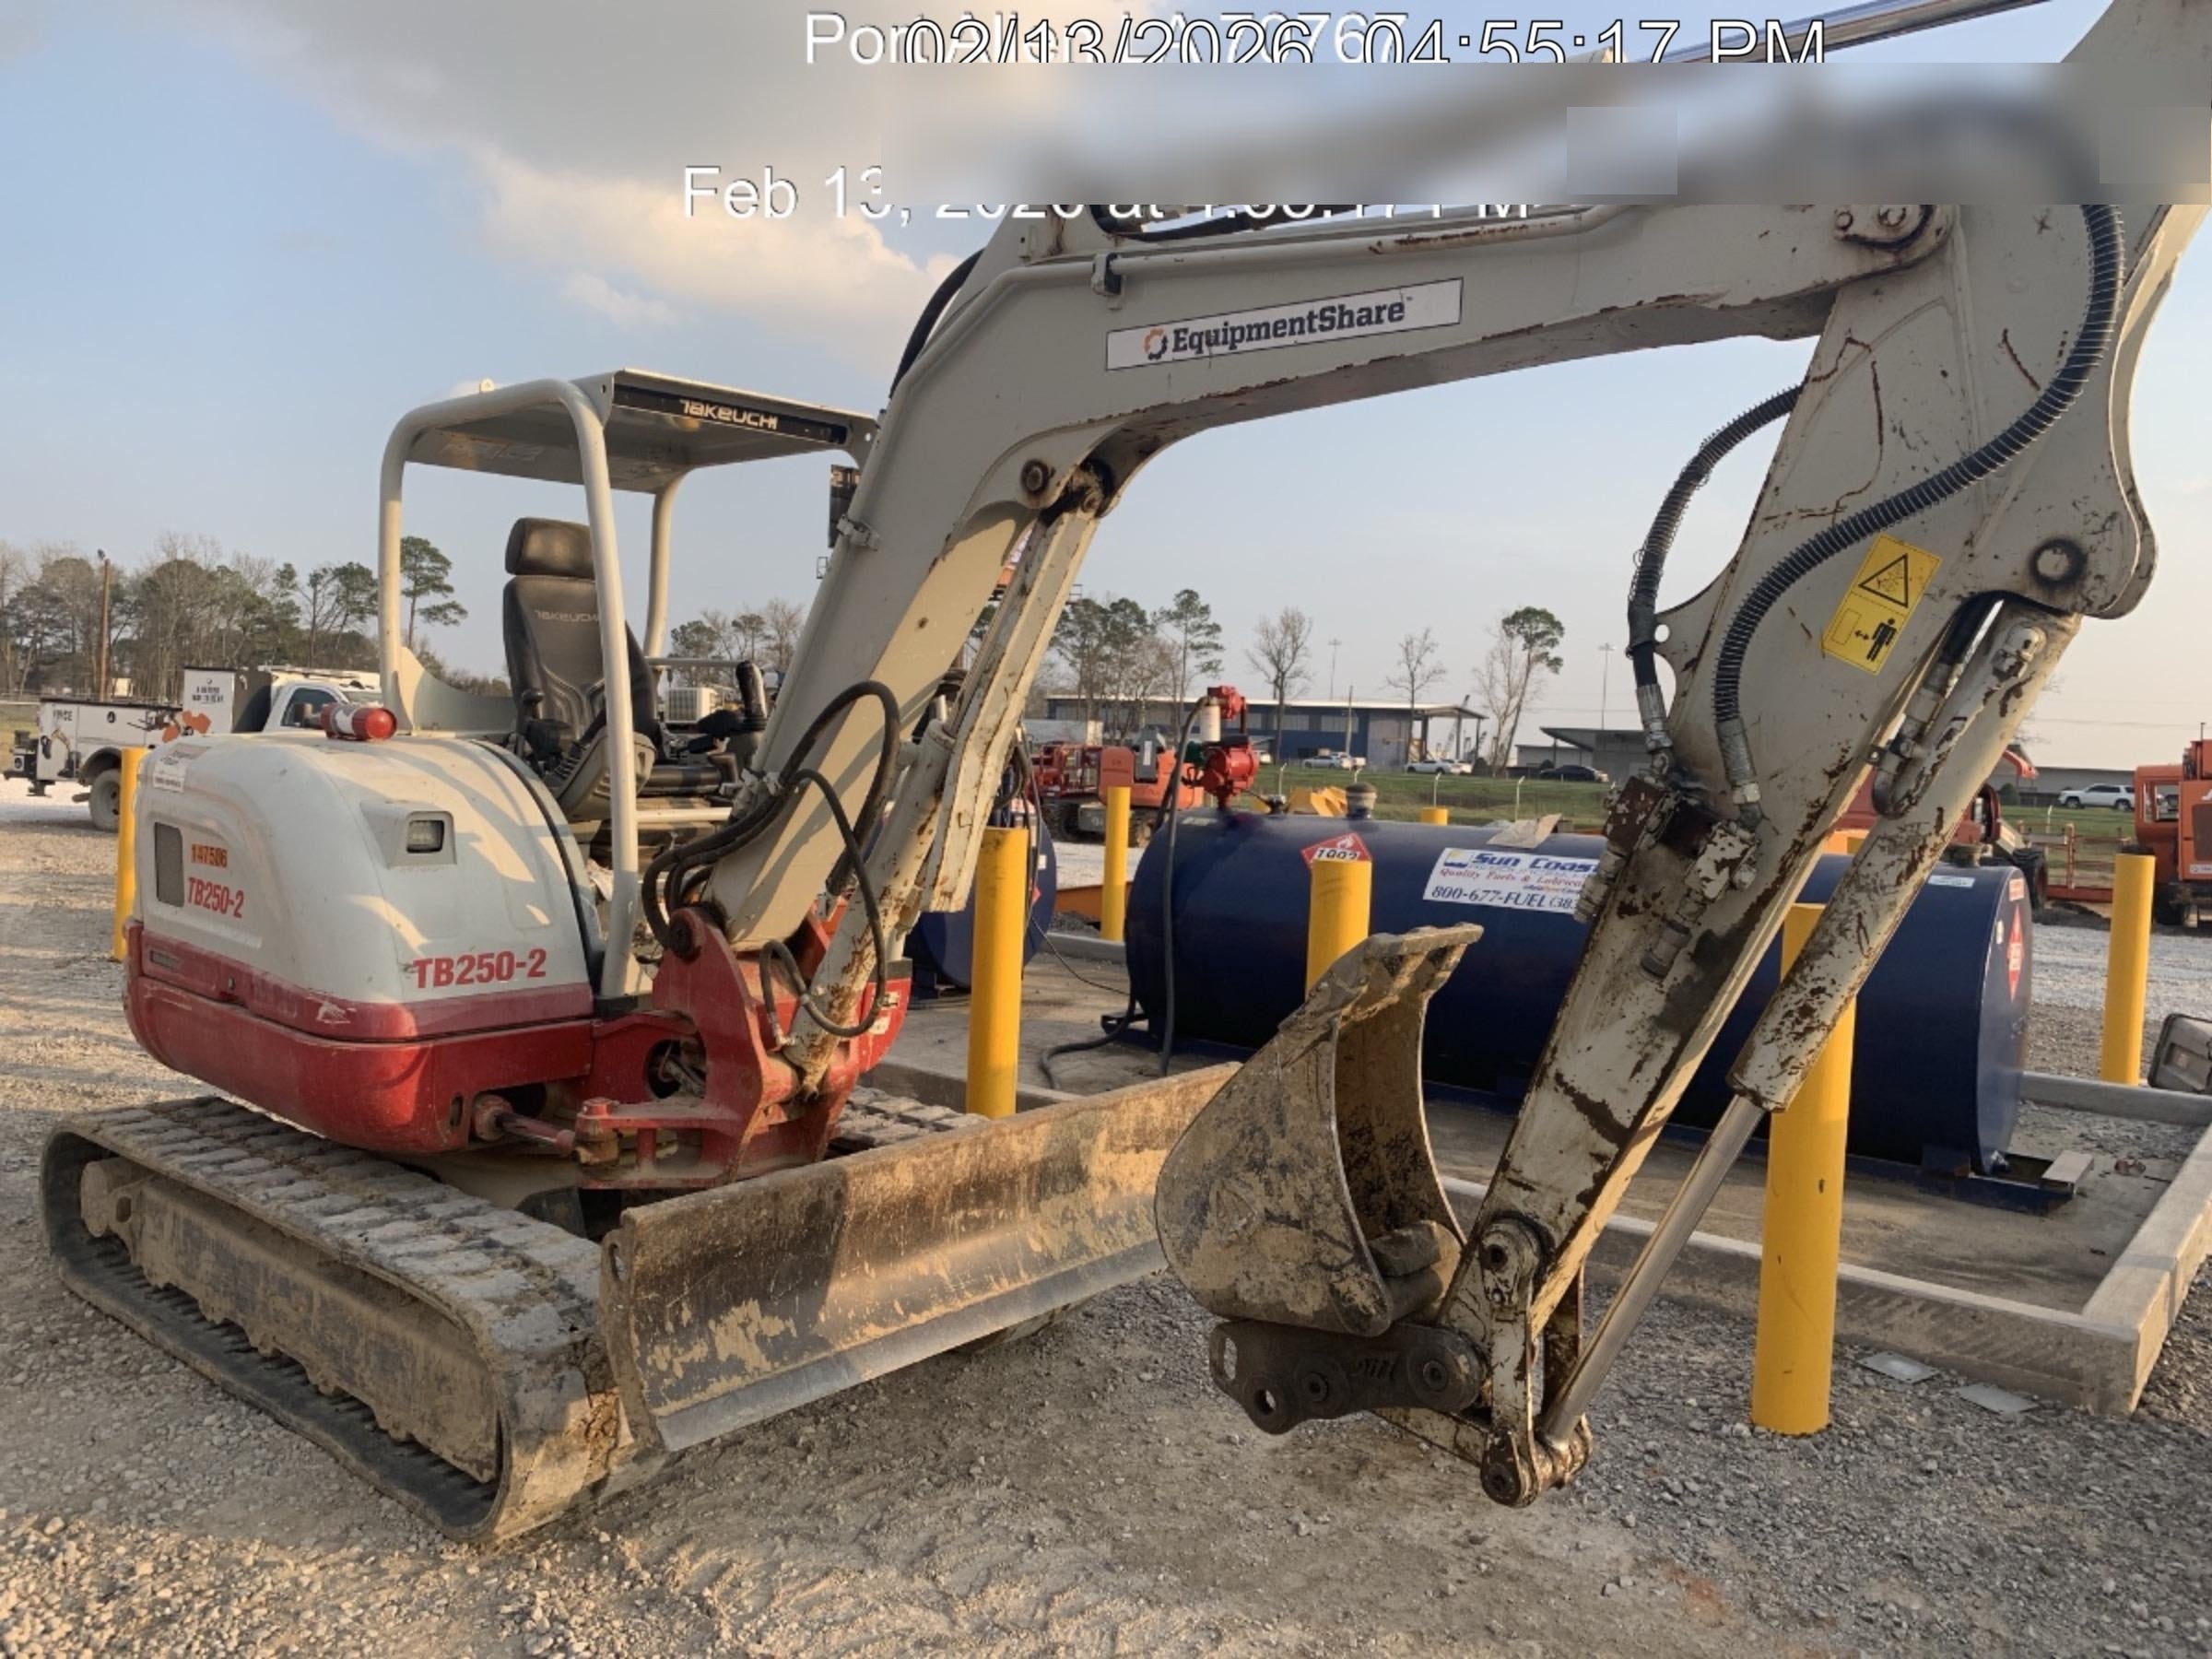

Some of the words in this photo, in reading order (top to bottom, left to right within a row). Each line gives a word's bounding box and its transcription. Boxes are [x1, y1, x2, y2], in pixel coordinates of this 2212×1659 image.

[1171, 300, 1406, 355] EquipmentShare
[678, 398, 779, 431] TAKEUCHI
[1440, 868, 1480, 879] Quality
[1472, 853, 1521, 867] Sun
[188, 877, 244, 919] TB250-2
[1431, 886, 1547, 908] 800-677-FUEL
[413, 947, 547, 989] TB250-2
